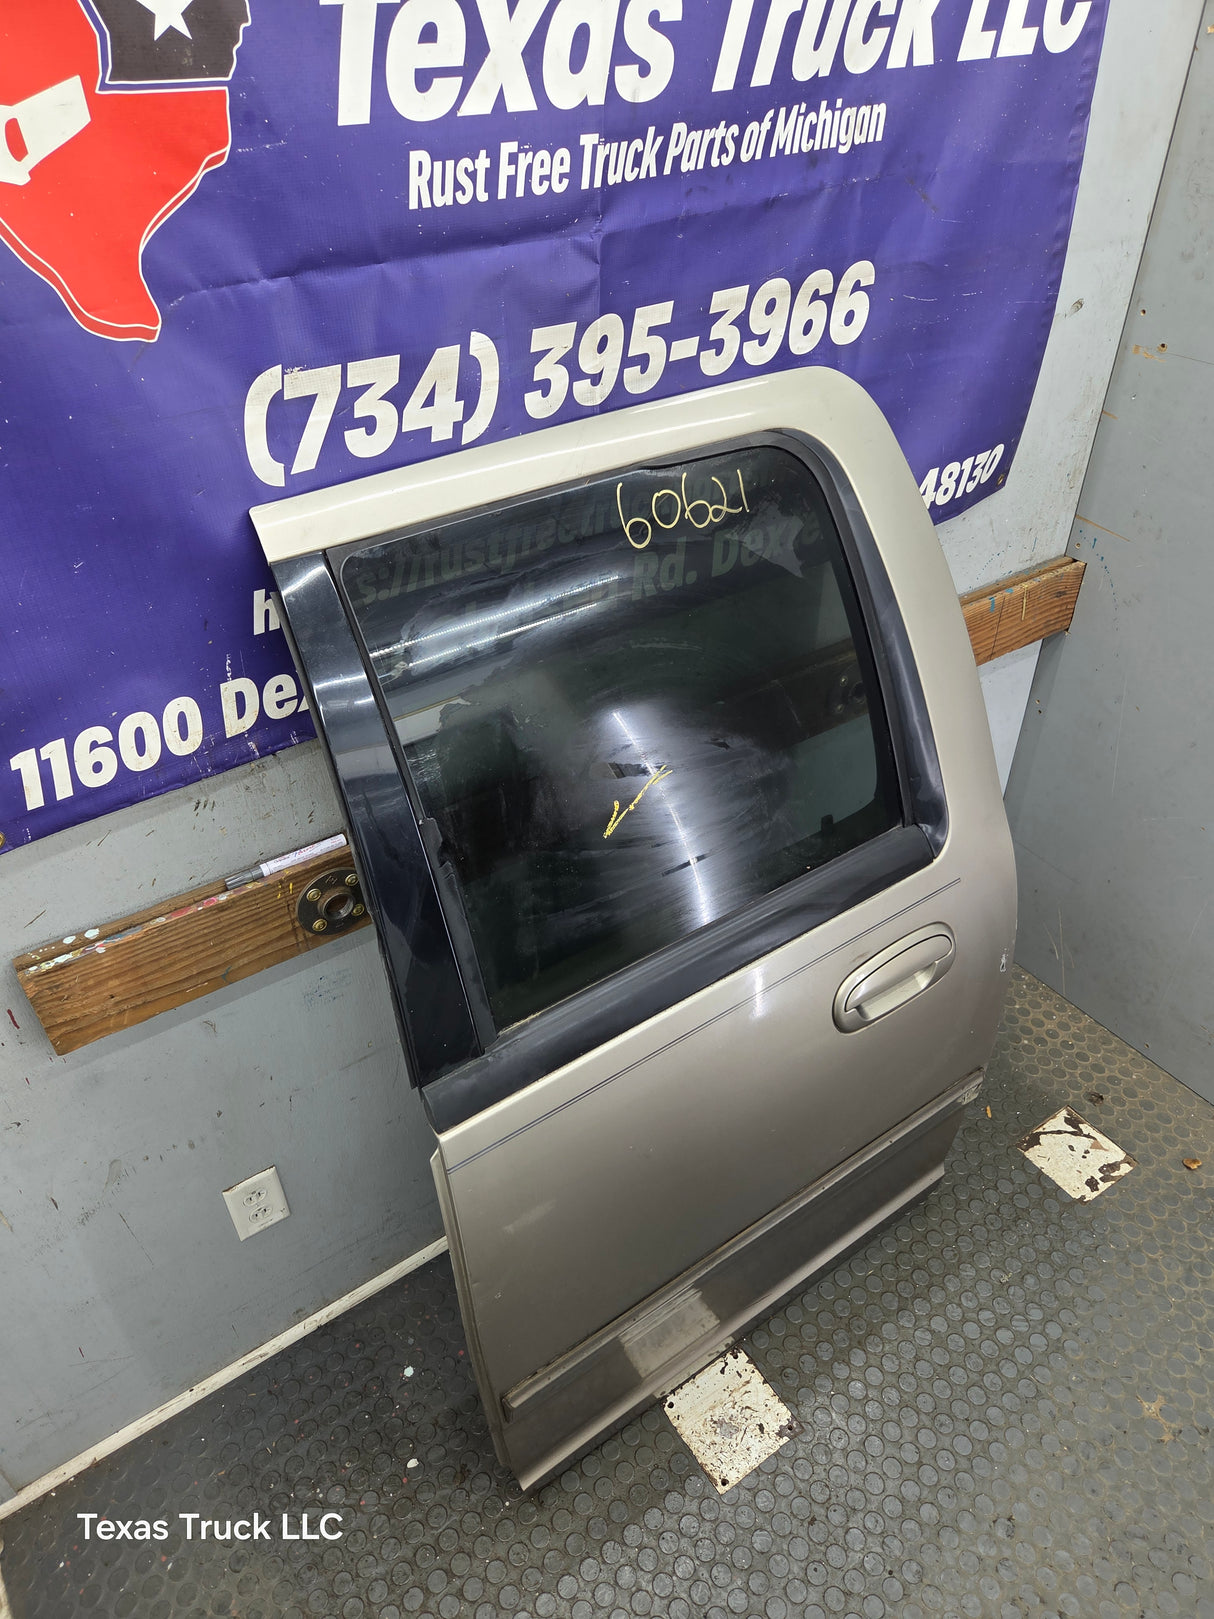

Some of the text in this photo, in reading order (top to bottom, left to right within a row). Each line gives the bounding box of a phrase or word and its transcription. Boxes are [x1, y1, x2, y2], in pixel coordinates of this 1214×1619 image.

[319, 0, 1093, 127] Texas Truck LLC
[408, 98, 888, 210] Rust Free Truck Parts of Michigan
[243, 260, 876, 487] (734) 395-3966
[616, 468, 750, 549] 60621
[9, 696, 204, 812] 11600
[219, 673, 310, 739] De
[918, 443, 1005, 510] 48130
